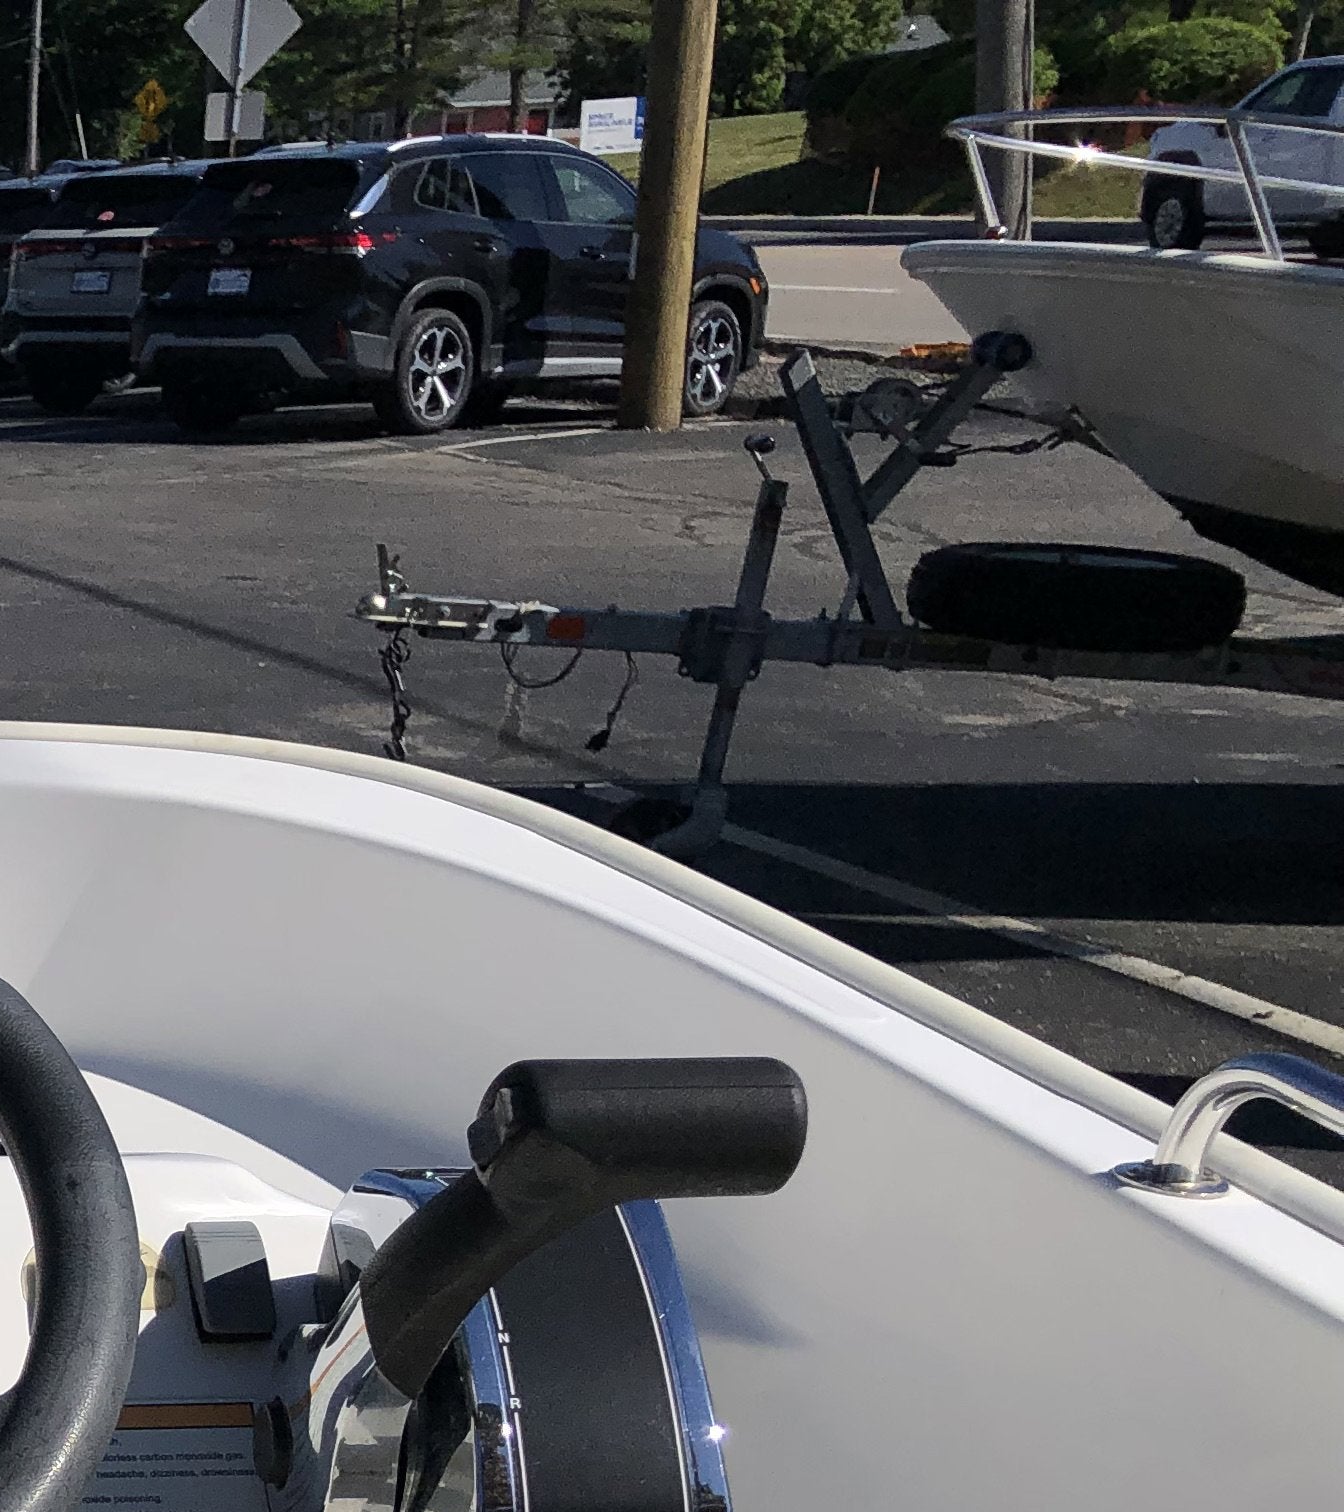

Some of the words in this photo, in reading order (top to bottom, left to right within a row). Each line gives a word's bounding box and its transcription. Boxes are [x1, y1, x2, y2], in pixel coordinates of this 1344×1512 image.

[497, 1332, 510, 1343] N
[509, 1397, 522, 1409] R
[139, 1453, 173, 1461] carbon
[176, 1452, 223, 1462] monoxide
